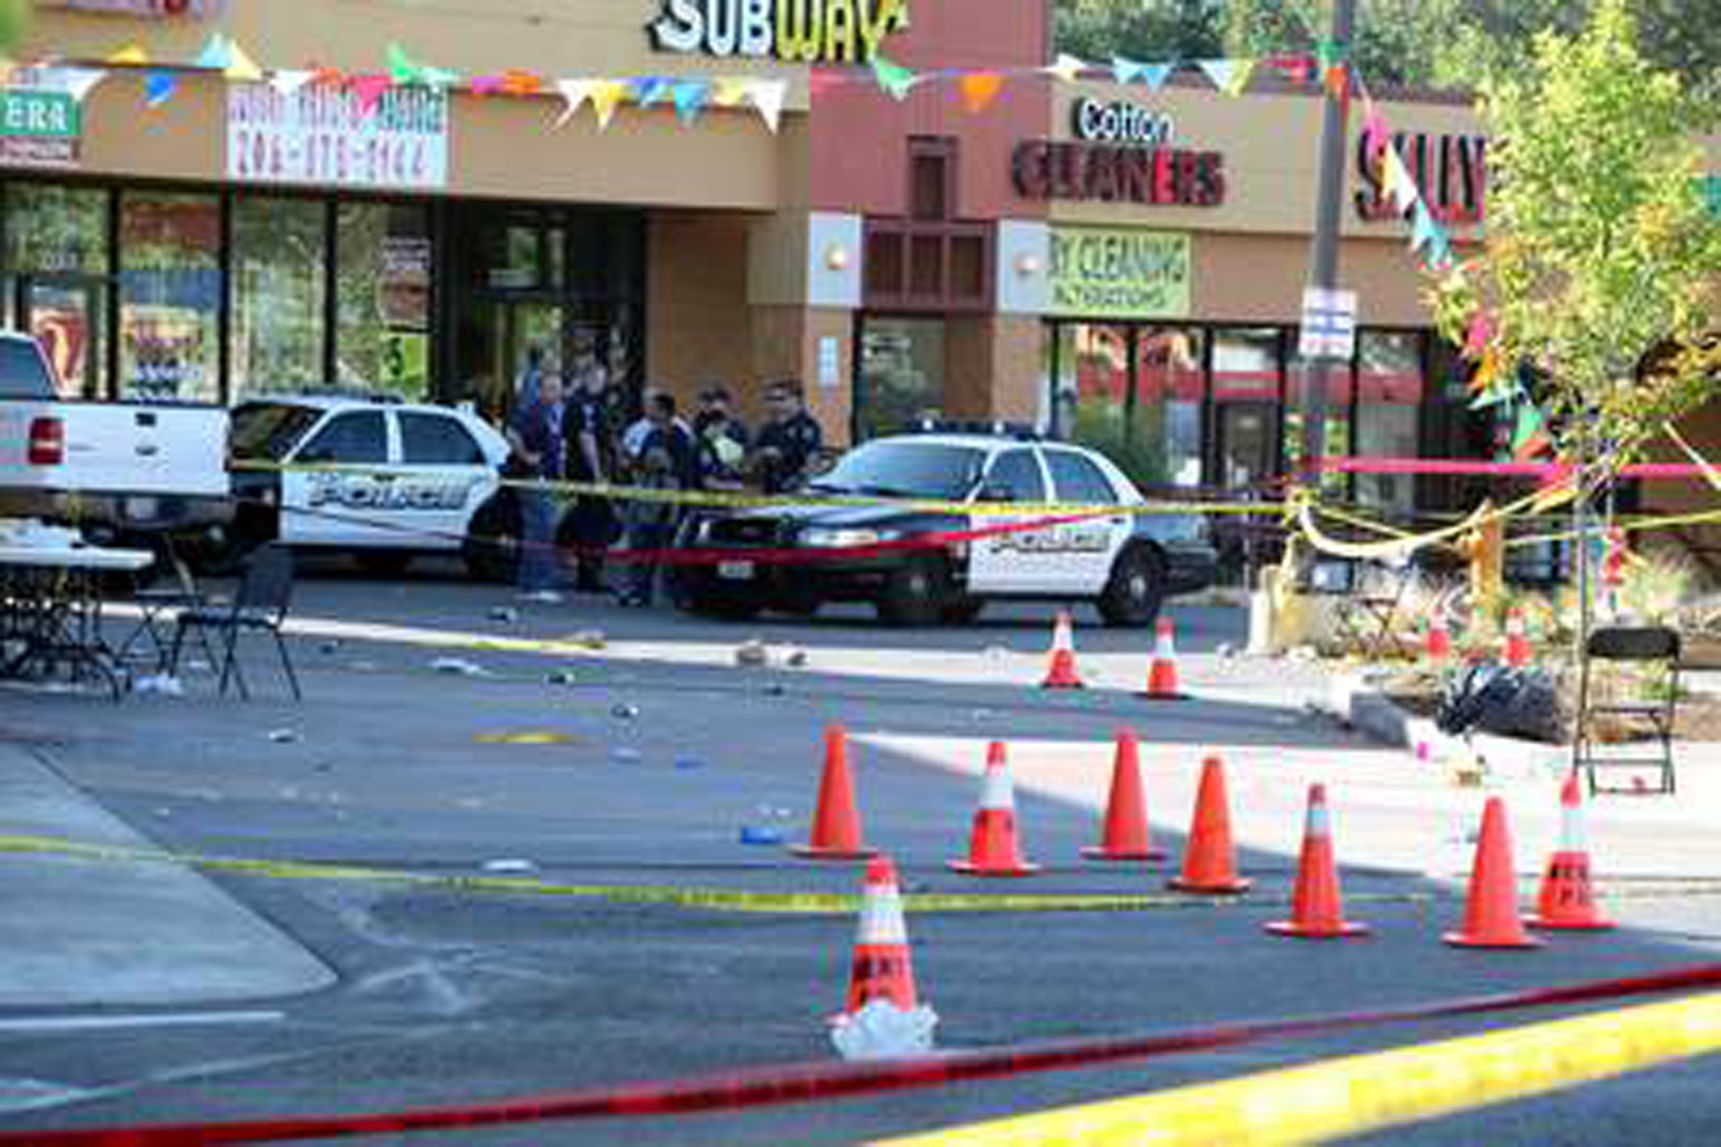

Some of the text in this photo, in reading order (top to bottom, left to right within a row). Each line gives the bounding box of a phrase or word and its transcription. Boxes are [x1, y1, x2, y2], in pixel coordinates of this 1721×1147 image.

[653, 0, 908, 62] SUBWAY
[1074, 97, 1174, 143] Cotton
[1013, 140, 1225, 206] CLEANERS
[309, 479, 469, 510] POLICE
